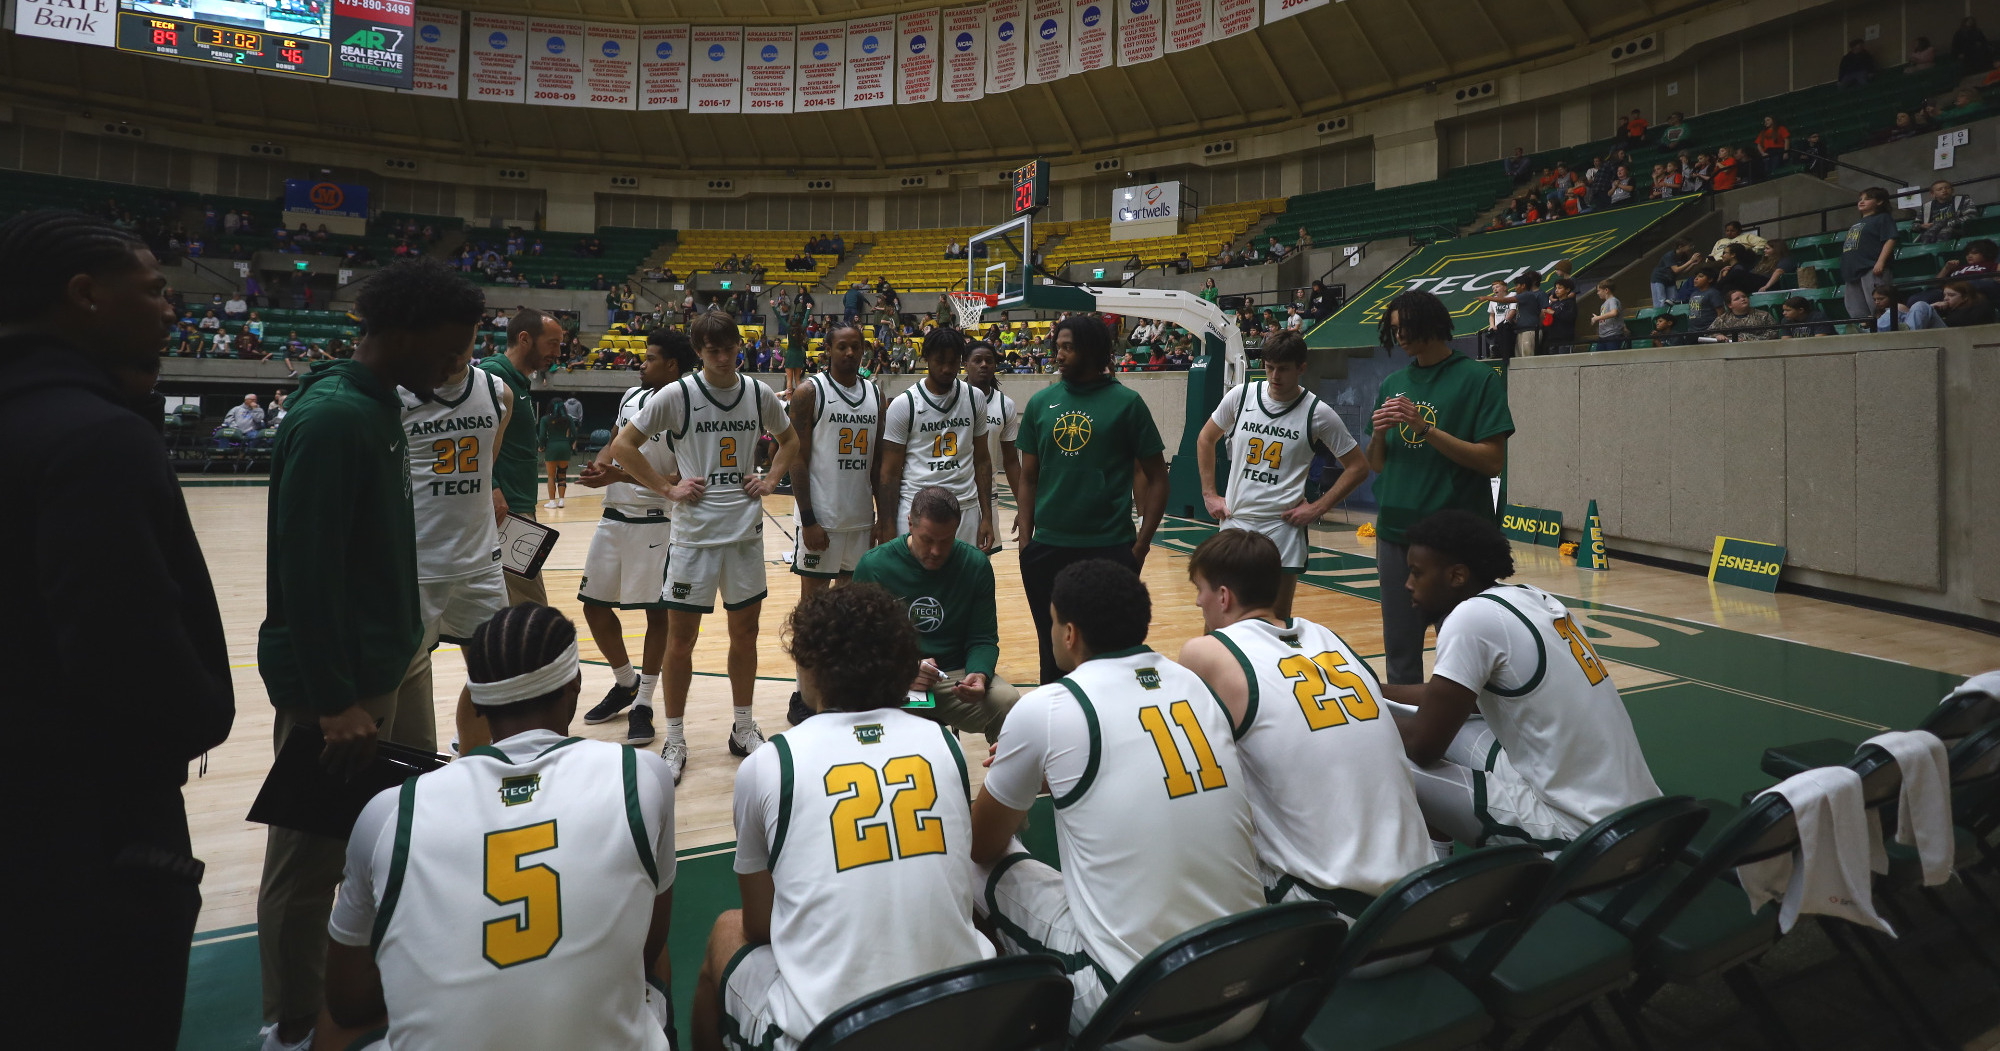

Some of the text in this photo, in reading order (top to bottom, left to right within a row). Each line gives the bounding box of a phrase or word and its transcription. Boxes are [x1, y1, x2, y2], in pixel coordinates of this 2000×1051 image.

[1037, 1, 1061, 12] WOMEN'S
[34, 7, 98, 32] Bank
[900, 13, 926, 22] ARKANSAS
[945, 9, 972, 18] ARKANSAS
[953, 16, 977, 24] WOMEN'S
[993, 11, 1021, 22] BASKETBALL
[1033, 9, 1064, 21] BASKETBALL
[1083, 14, 1101, 24] NCAA
[150, 20, 176, 30] TECH
[850, 22, 878, 30] ARKANSAS
[904, 25, 934, 35] BASKETBALL
[949, 23, 981, 32] BASKETBALL
[153, 29, 178, 46] 89
[1000, 29, 1015, 38] NCAA
[1041, 27, 1058, 37] NCAA
[212, 29, 258, 49] 3:02
[284, 40, 297, 48] EC
[341, 29, 386, 51] AR
[957, 40, 974, 49] NCAA
[156, 46, 179, 55] BONUS
[911, 42, 927, 51] NCAA
[211, 50, 234, 59] PERIOD
[234, 52, 246, 65] 2
[281, 49, 305, 64] 46
[340, 45, 403, 63] REAL ESTATE
[275, 63, 296, 71] BONUS
[340, 54, 403, 70] COLLECTIVE
[854, 60, 886, 68] CONFERENCE
[479, 86, 515, 97] 2012-13
[534, 91, 577, 101] 2008-09
[854, 91, 885, 102] 2012-13
[590, 94, 628, 104] 2020-21
[648, 96, 679, 105] 2017-18
[698, 99, 731, 107] 2016-17
[751, 100, 784, 108] 2015-16
[804, 98, 836, 107] 2014-15
[1016, 182, 1032, 212] 20
[1118, 202, 1171, 222] Chartwells
[1406, 258, 1570, 297] TECH
[829, 412, 877, 425] ARKANSAS
[1056, 410, 1094, 423] ARKANSAS
[410, 415, 493, 437] ARKANSAS
[695, 420, 757, 434] ARKANSAS
[920, 417, 971, 434] ARKANSAS
[1241, 421, 1300, 441] ARKANSAS
[838, 428, 869, 456] 24
[932, 432, 959, 458] 13
[432, 435, 480, 475] 32
[719, 437, 738, 468] 2
[1246, 437, 1284, 470] 34
[838, 459, 868, 471] TECH
[928, 460, 961, 473] TECH
[1243, 468, 1280, 485] TECH
[429, 479, 482, 497] TECH
[1502, 515, 1538, 533] SUNS
[1590, 515, 1609, 569] TECH
[1718, 553, 1780, 577] OFFENSE
[672, 587, 691, 595] TECH
[914, 607, 938, 616] TECH
[1138, 673, 1161, 684] TECH
[1277, 650, 1380, 732] 25
[856, 729, 884, 739] TECH
[1138, 699, 1229, 800] 11
[501, 782, 538, 799] TECH
[823, 754, 948, 873] 22
[483, 819, 563, 970] 5
